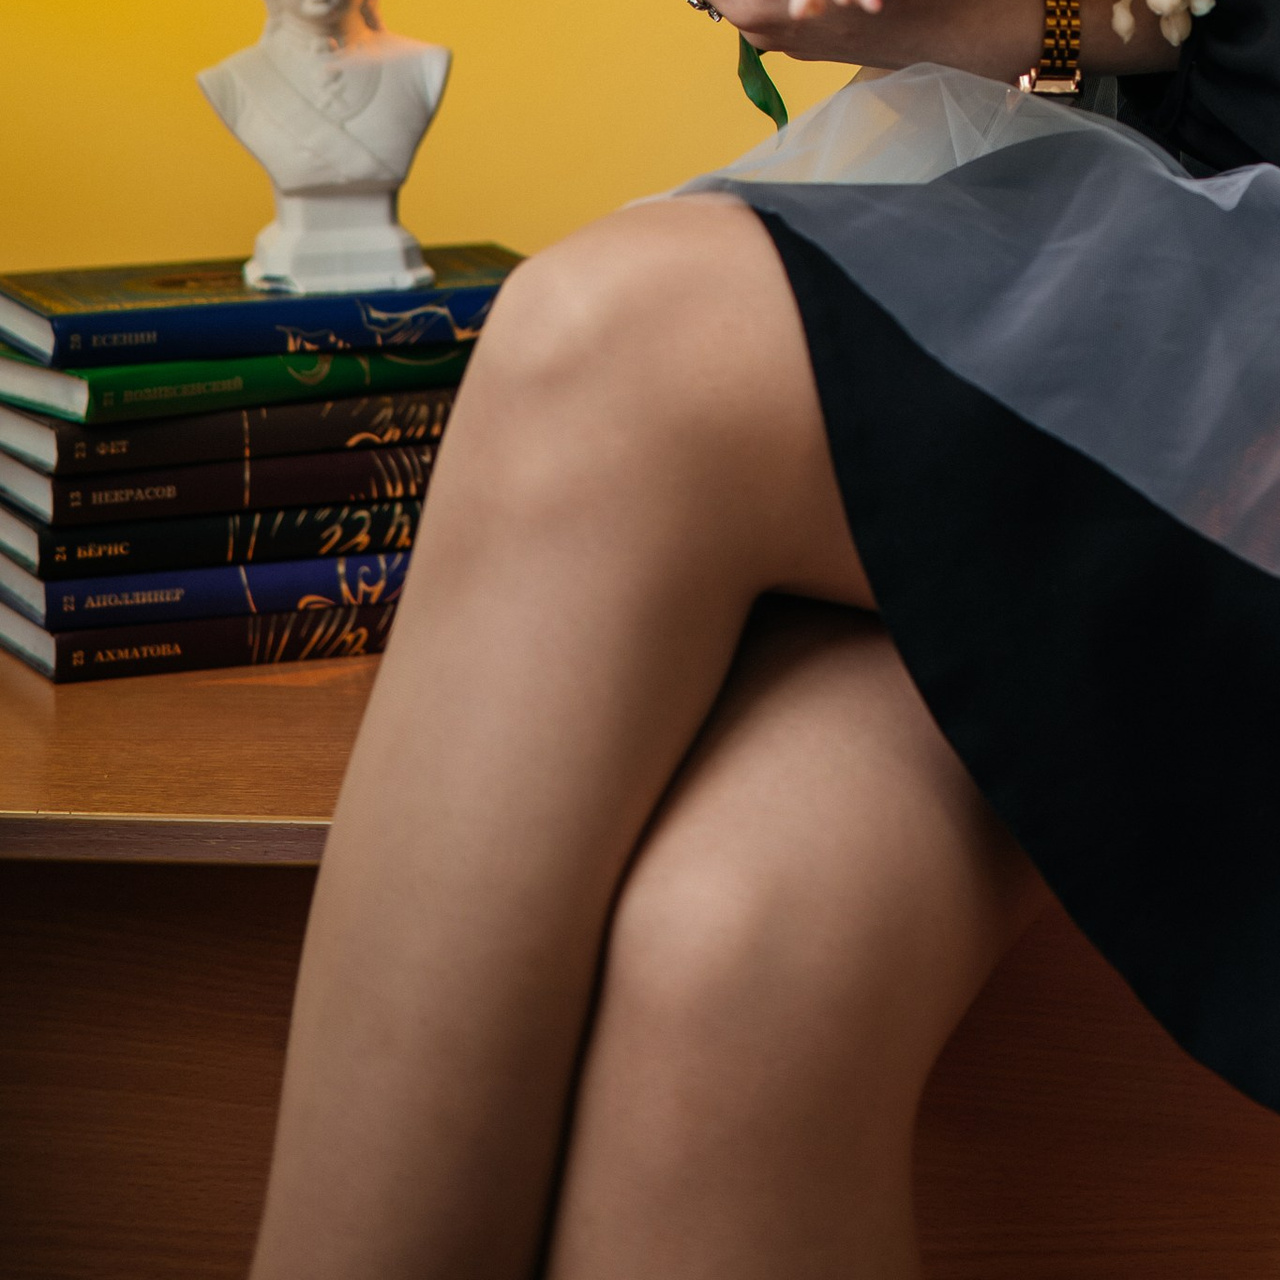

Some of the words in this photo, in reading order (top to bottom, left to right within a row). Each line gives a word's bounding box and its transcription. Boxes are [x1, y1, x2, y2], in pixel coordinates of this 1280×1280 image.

[91, 331, 158, 348] ЕСЕНИН
[123, 376, 243, 403] ВОЗНЕСЕНСКИЙ
[96, 440, 129, 455] ФЕТ
[92, 485, 177, 505] НЕКРАСОВ
[77, 542, 130, 559] БЁРНС
[85, 588, 184, 608] АПОЛЛИНЕР
[94, 643, 182, 662] АХМАТОВА
